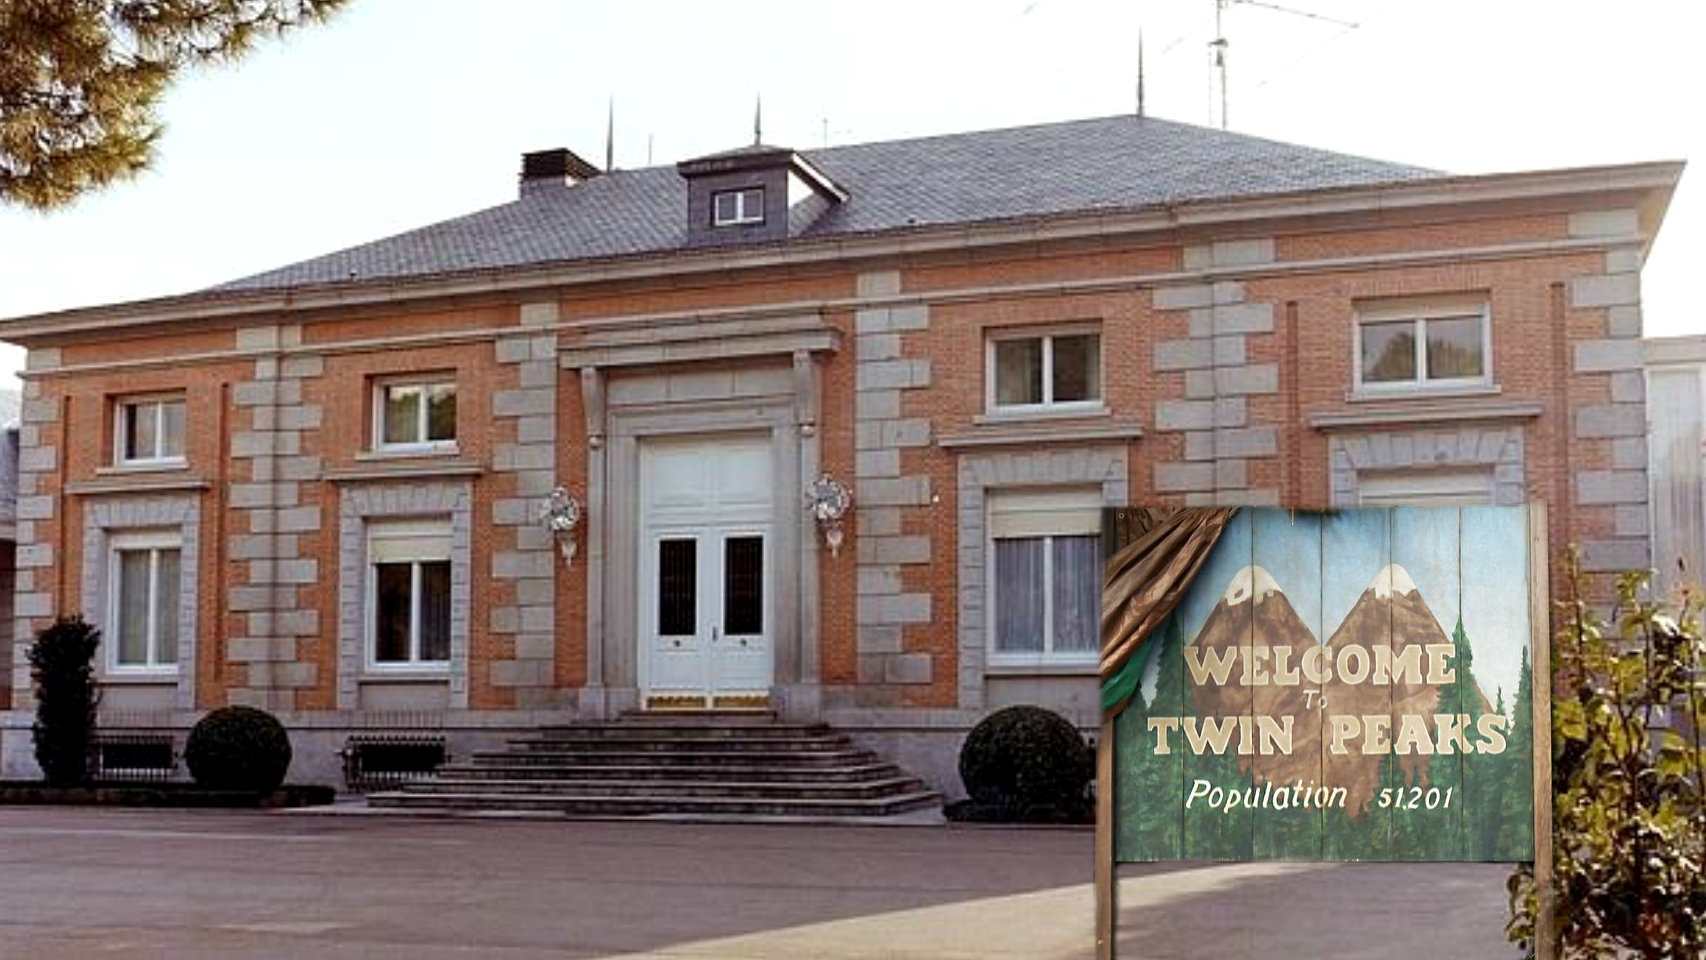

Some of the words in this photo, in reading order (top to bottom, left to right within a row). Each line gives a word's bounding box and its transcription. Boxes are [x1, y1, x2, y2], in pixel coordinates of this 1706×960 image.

[1184, 644, 1456, 686] WELCOME
[1303, 689, 1329, 710] To
[1147, 716, 1295, 755] TWIN
[1330, 713, 1508, 755] PEAKS
[1185, 779, 1347, 813] Population
